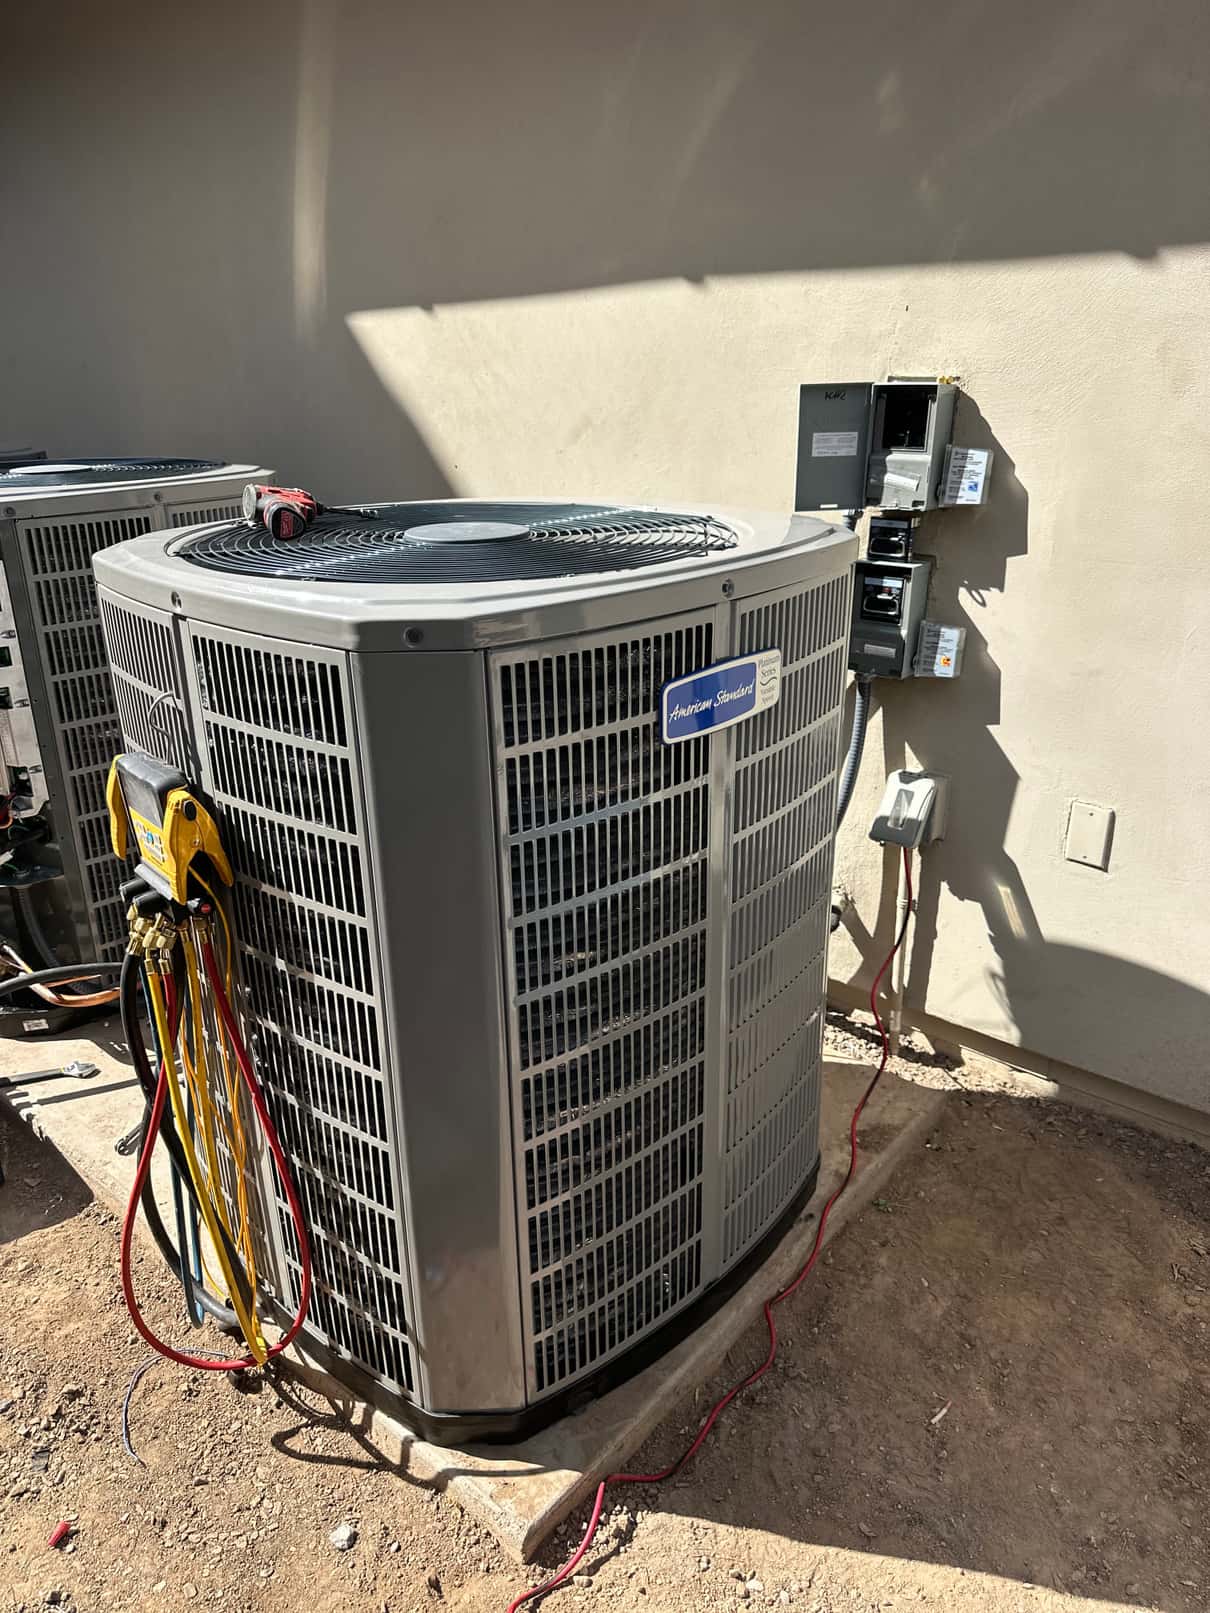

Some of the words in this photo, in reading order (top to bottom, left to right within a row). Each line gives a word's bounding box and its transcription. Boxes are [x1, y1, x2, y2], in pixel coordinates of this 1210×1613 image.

[761, 667, 777, 678] Series
[669, 699, 713, 722] American
[713, 678, 755, 707] Standard
